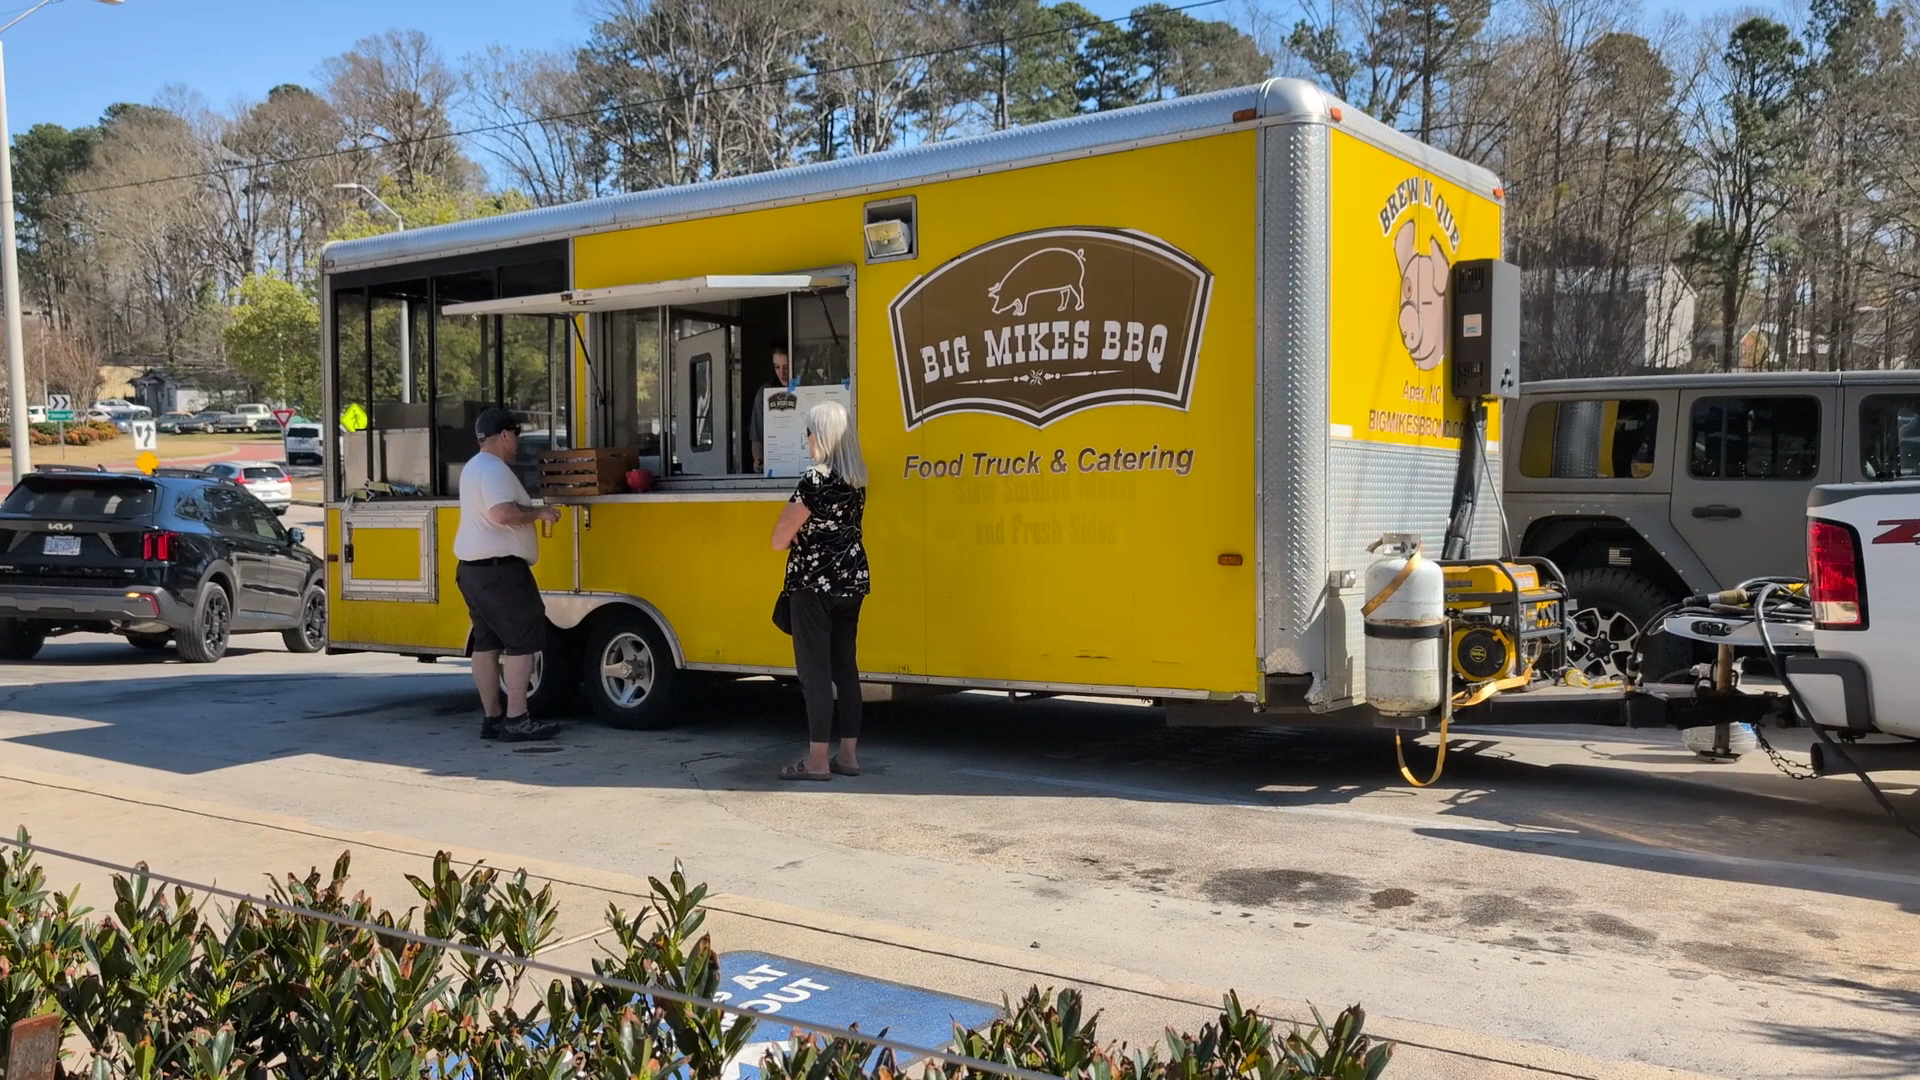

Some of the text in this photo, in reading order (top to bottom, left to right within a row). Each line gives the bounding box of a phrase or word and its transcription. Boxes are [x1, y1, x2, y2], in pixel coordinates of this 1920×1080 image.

[1380, 177, 1459, 251] BREW N QUE
[920, 319, 1168, 384] BIG MIKES BBQ
[1402, 380, 1442, 404] Apex, NC
[1368, 409, 1464, 438] BIGMIKESBBQNC.CO
[903, 445, 1195, 479] Food Truck & Catering
[48, 522, 74, 531] KIA
[731, 963, 789, 990] AT
